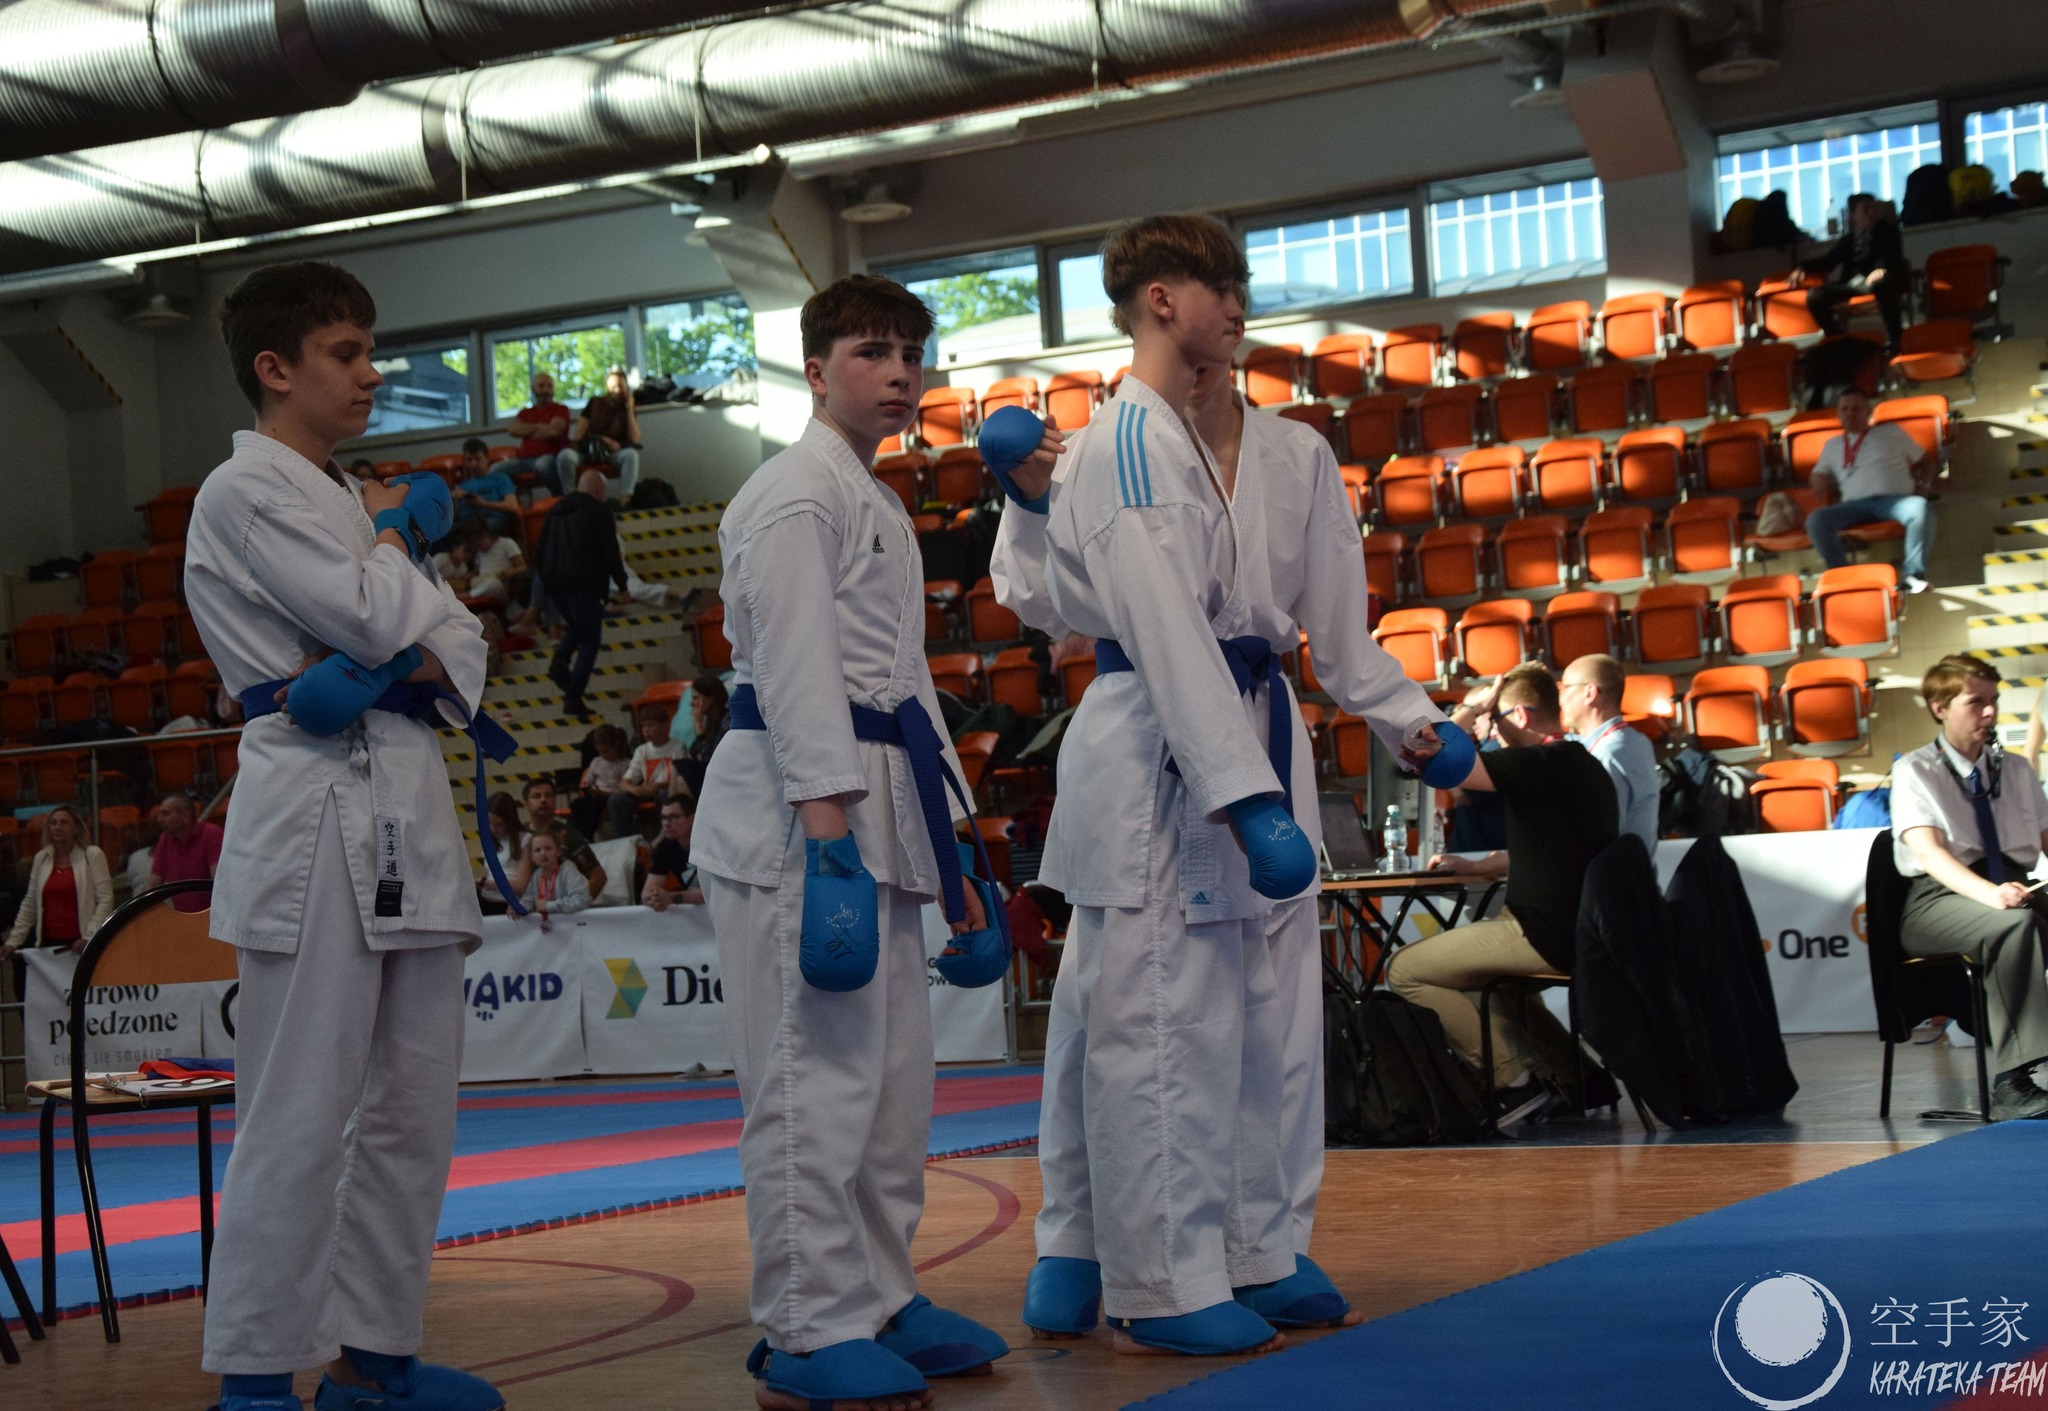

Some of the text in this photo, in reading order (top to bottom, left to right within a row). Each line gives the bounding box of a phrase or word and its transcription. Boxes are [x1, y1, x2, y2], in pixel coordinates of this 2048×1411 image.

[384, 821, 398, 877] 空手道
[1778, 929, 1850, 960] One
[661, 964, 724, 1006] Di
[50, 1009, 178, 1045] pedzone
